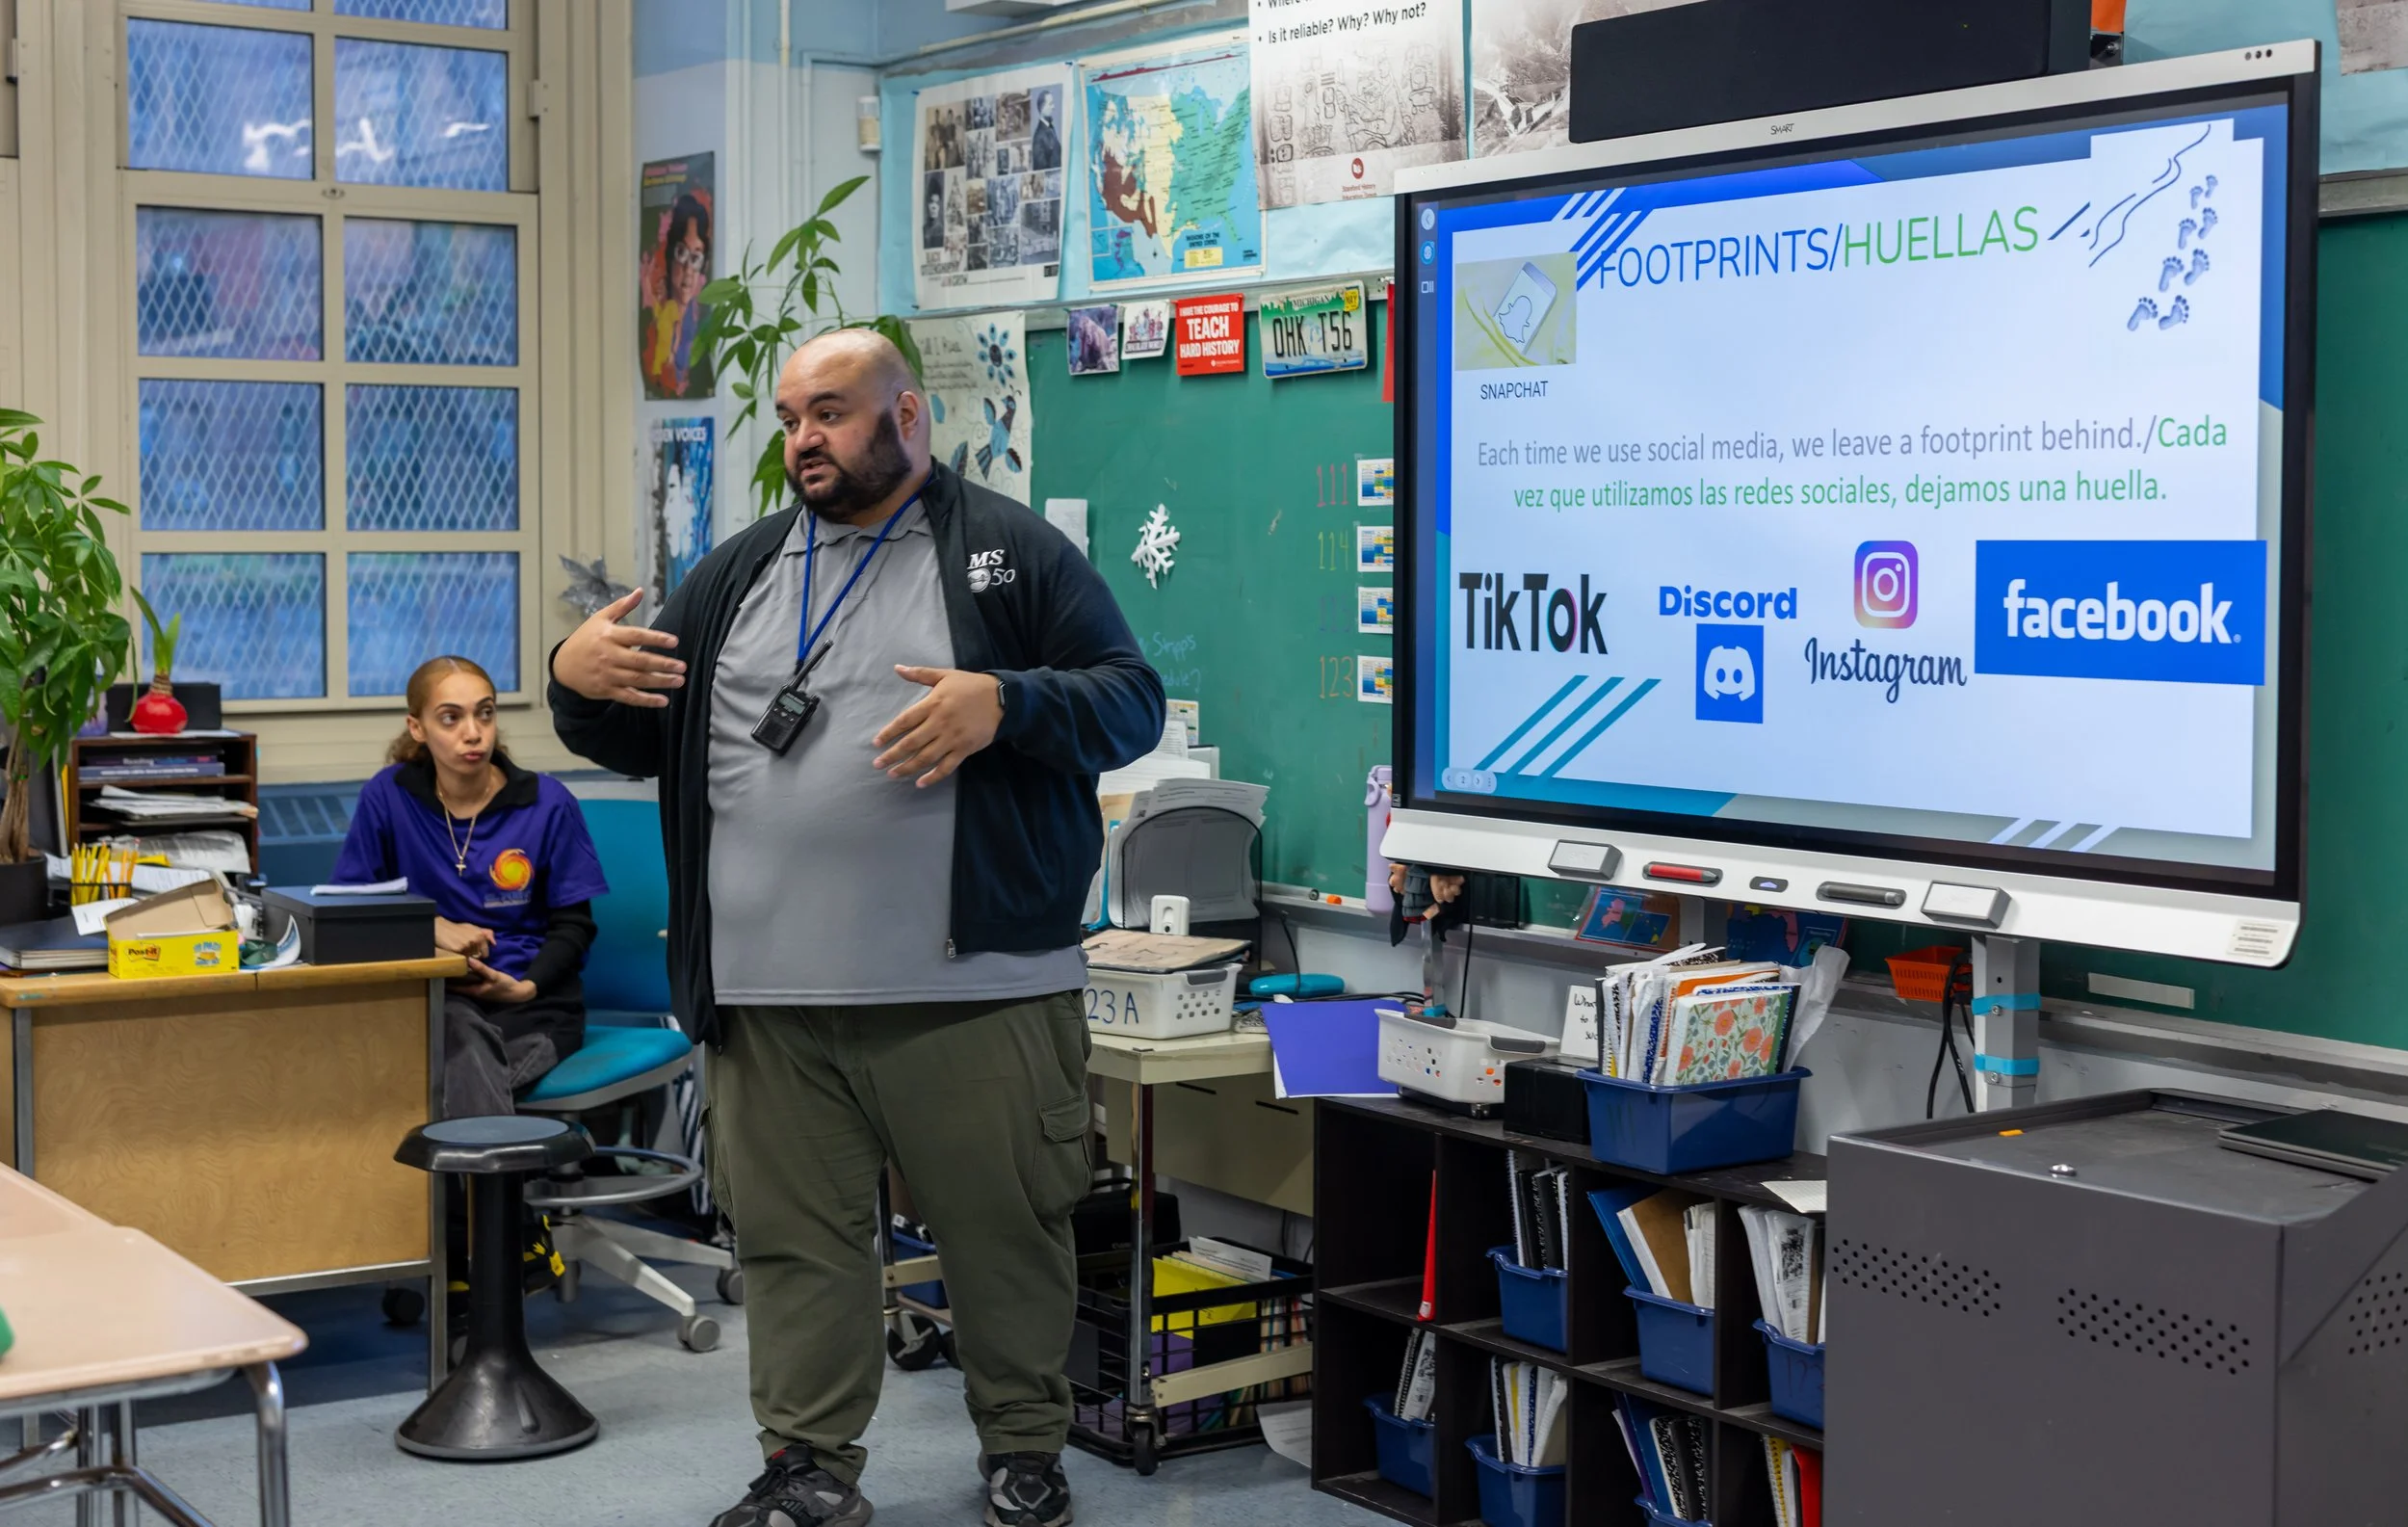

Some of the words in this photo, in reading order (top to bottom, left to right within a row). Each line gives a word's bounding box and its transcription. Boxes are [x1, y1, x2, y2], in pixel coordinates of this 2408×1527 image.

[1269, 30, 1277, 43] Is
[1279, 28, 1288, 41] it
[1290, 19, 1334, 39] reliable?
[1337, 13, 1370, 31] Why?
[1373, 9, 1399, 25] Why
[1401, 2, 1426, 20] not?
[1770, 122, 1795, 136] SMART
[1292, 294, 1331, 306] MICHIGAN
[1186, 315, 1230, 341] TEACH
[1318, 310, 1352, 354] T56
[1179, 342, 1202, 358] HARD
[1201, 338, 1241, 356] HISTORY
[1479, 381, 1549, 400] SNAPCHAT
[1479, 439, 1519, 466] Each
[1525, 440, 1567, 464] time
[1573, 444, 1602, 464] we
[1608, 441, 1641, 462] use
[1647, 433, 1705, 462] social
[1712, 431, 1784, 463] media,
[1792, 436, 1824, 458] we
[1832, 428, 1892, 457] leave
[1899, 434, 1913, 455] a
[1920, 424, 2033, 461] footprint
[1316, 462, 1349, 508] 111
[1513, 488, 1544, 508] vez
[1550, 487, 1585, 513] que
[1592, 480, 1692, 507] utilizamos
[1700, 478, 1727, 505] las
[1734, 477, 1793, 505] redes
[1800, 475, 1898, 509] sociales,
[1905, 473, 2010, 510] dejamos
[2019, 479, 2066, 501] una
[2076, 469, 2167, 500] huella.
[966, 548, 1006, 570] MS
[1317, 529, 1349, 571] 114
[990, 567, 1016, 586] 50
[1458, 572, 1609, 655] TikTok
[1659, 585, 1797, 619] Discord
[1320, 655, 1354, 698] 123
[1804, 637, 1968, 704] Instagram
[1123, 991, 1139, 1025] A
